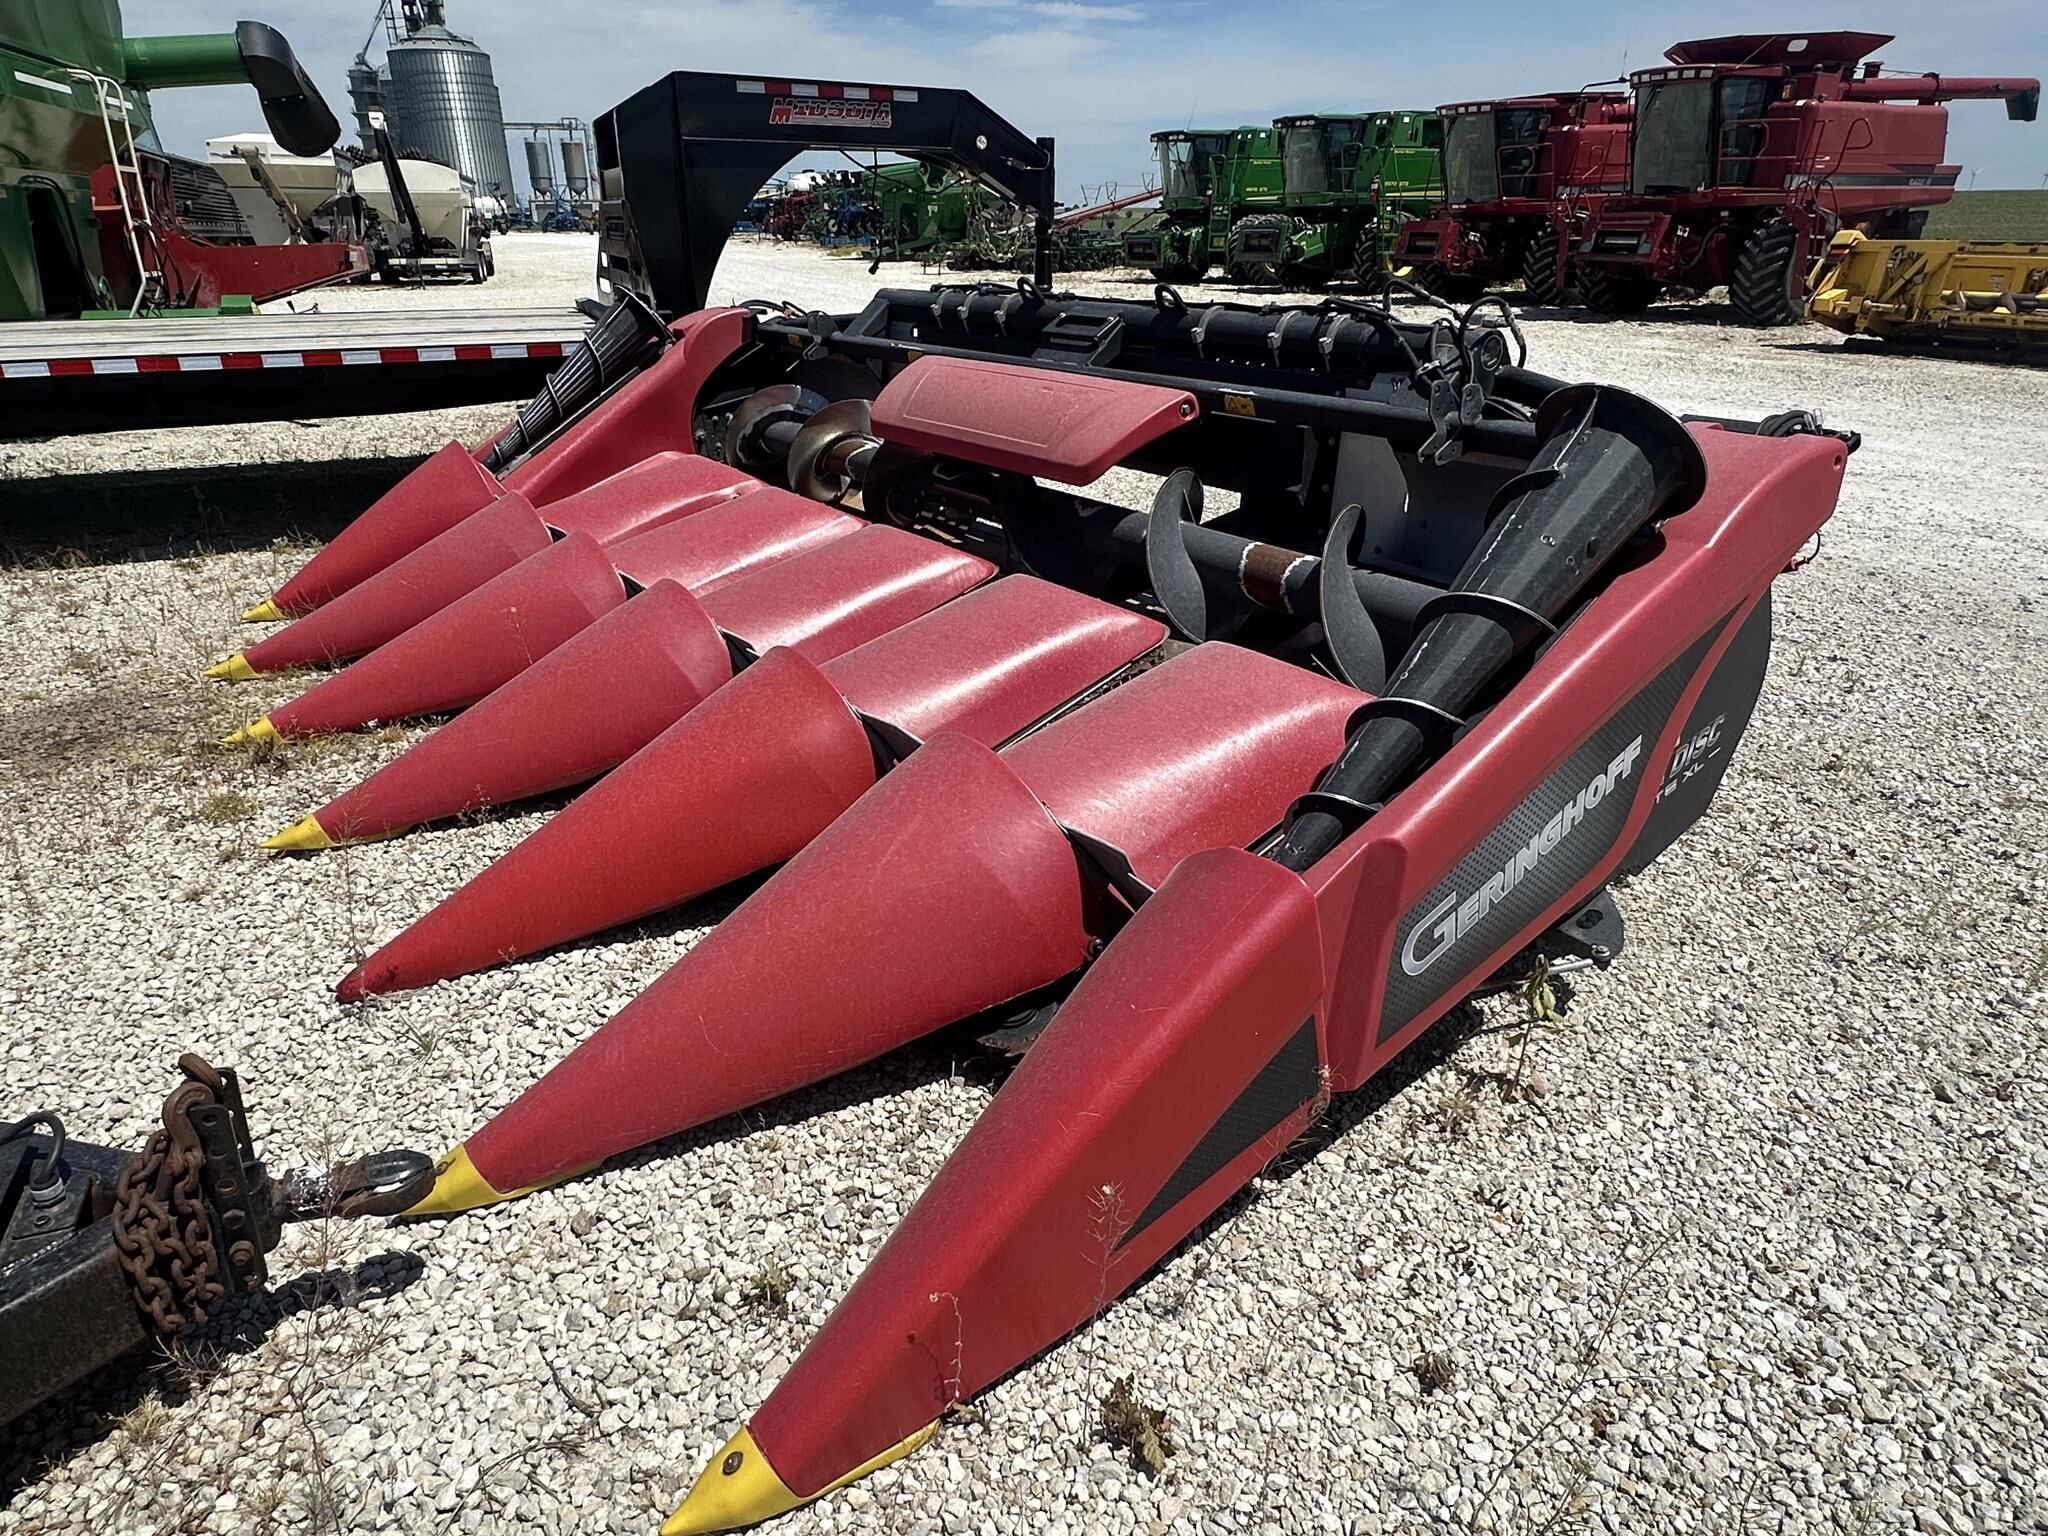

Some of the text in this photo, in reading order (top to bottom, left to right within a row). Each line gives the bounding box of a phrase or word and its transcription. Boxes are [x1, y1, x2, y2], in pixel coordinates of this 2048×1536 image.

[770, 98, 892, 125] MIDSOTA
[1670, 714, 1725, 778] DISC
[1401, 734, 1643, 977] GERINGHOFF
